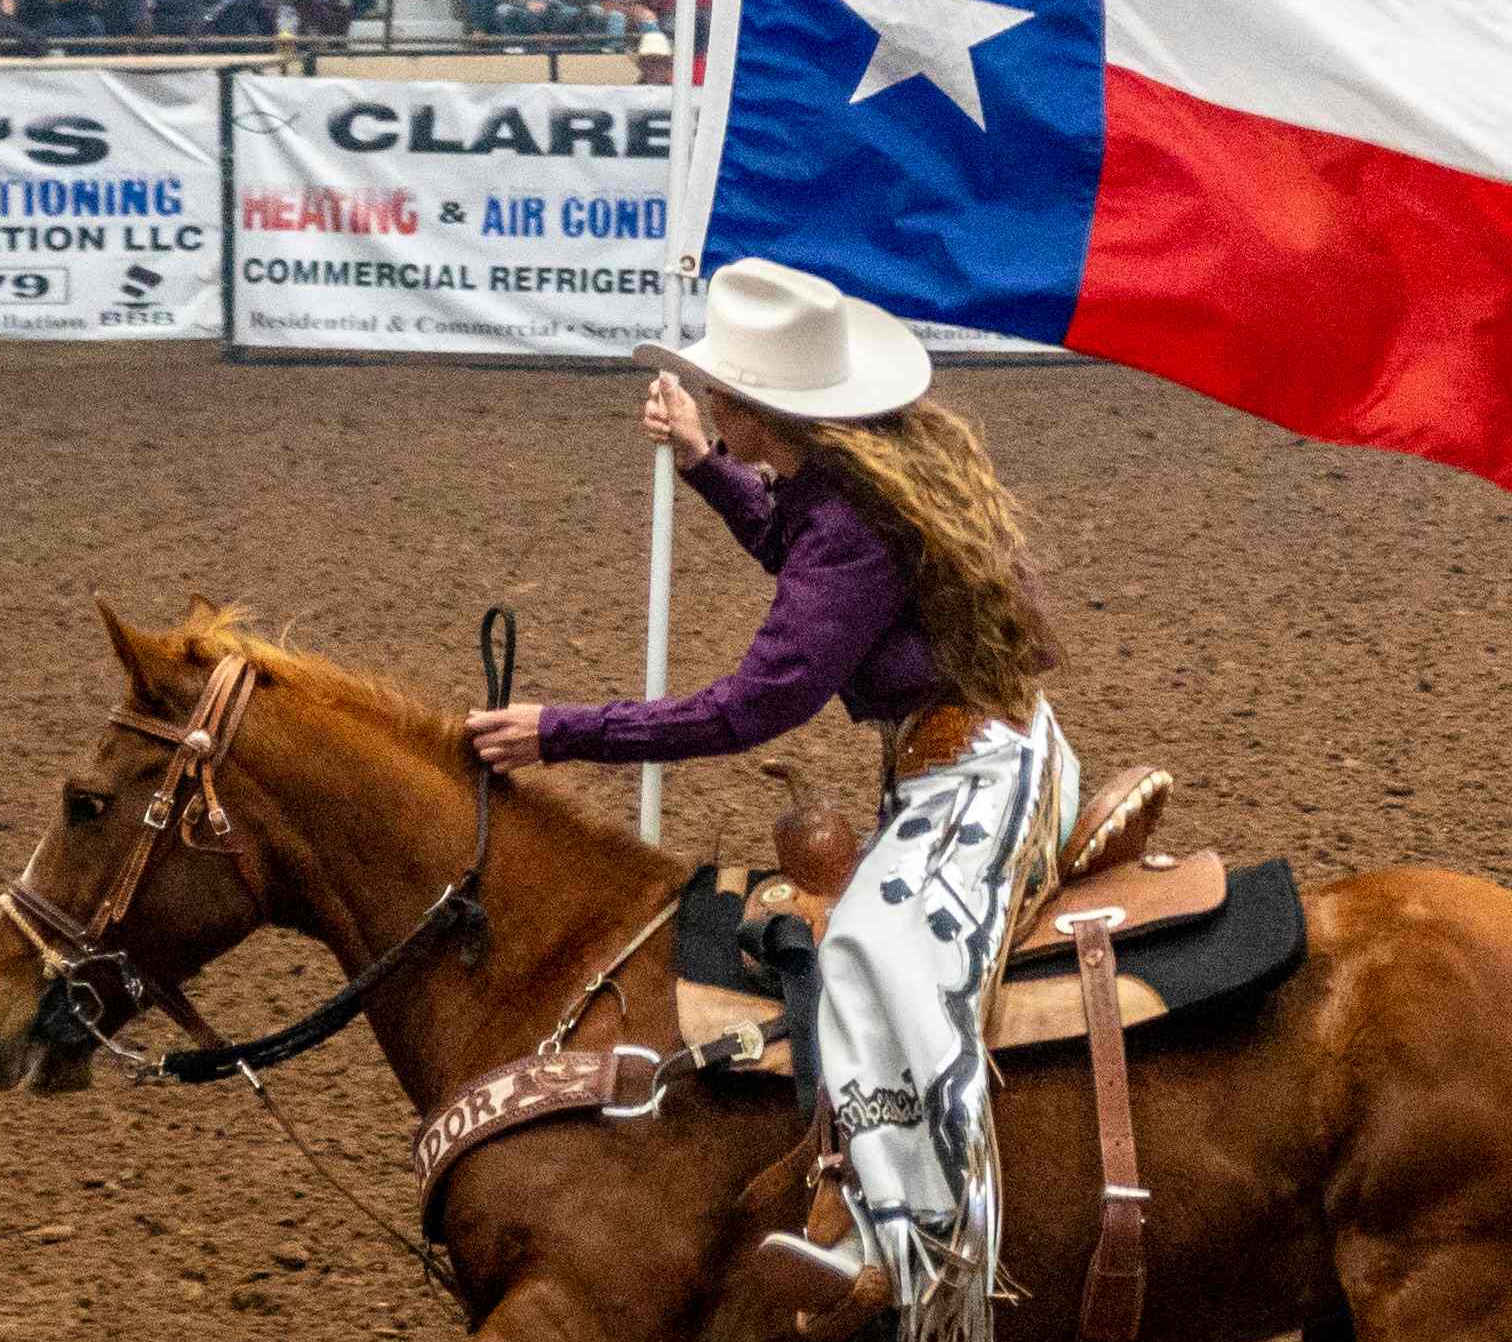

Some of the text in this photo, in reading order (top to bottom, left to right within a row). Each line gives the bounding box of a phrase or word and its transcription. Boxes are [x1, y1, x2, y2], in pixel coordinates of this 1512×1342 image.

[327, 102, 672, 158] CLARE
[242, 186, 669, 240] HEATING & AIR COND
[124, 225, 204, 253] LLC
[242, 258, 478, 292] COMMERCIAL
[97, 311, 177, 328] BBB
[248, 309, 380, 334] Residential
[414, 315, 561, 339] Commercial
